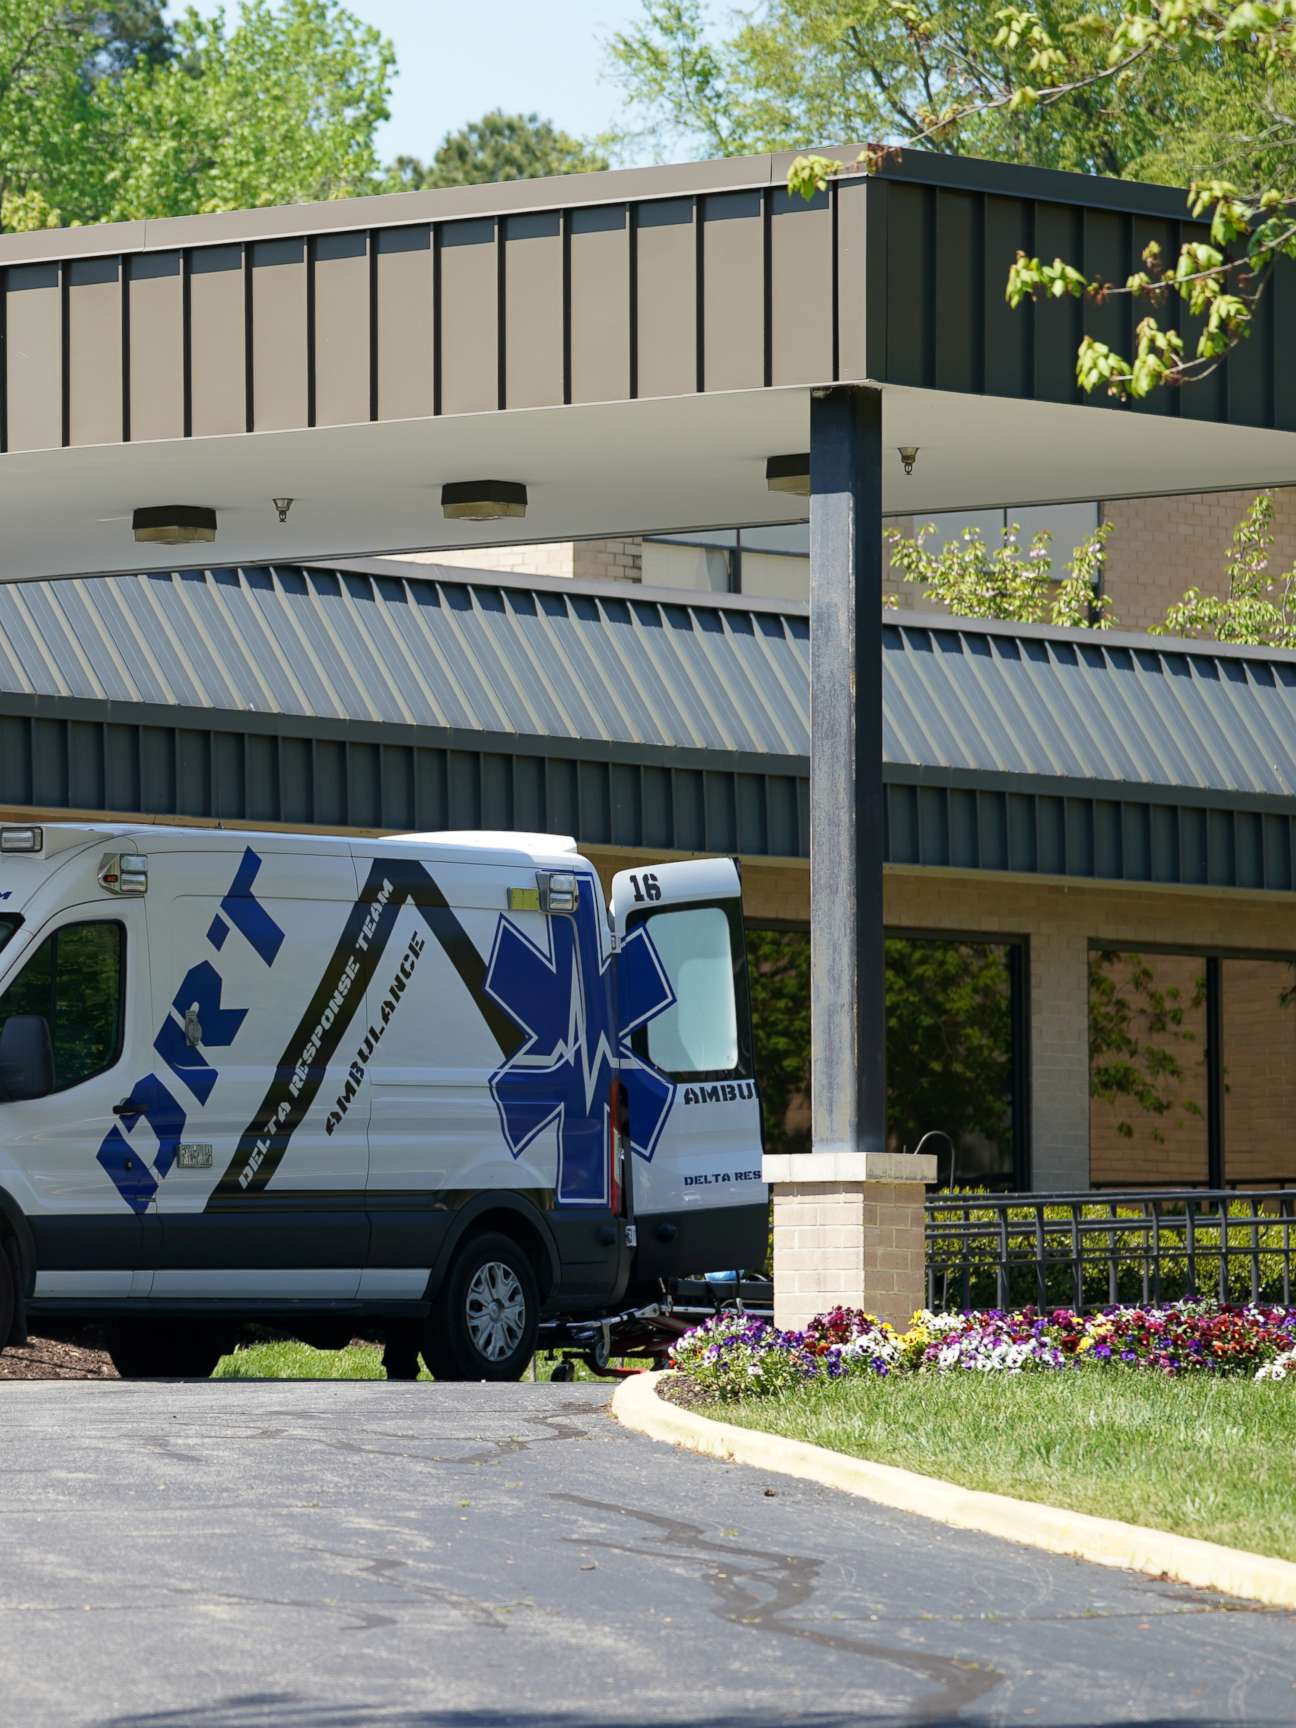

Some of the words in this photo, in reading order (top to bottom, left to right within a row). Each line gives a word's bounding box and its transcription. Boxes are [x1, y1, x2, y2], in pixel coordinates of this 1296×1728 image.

[629, 872, 662, 902] 16
[237, 1100, 292, 1190] DELTA
[288, 954, 361, 1098] RESPONSE
[355, 876, 395, 952] TEAM
[324, 929, 426, 1137] AMBULANCE
[684, 1172, 731, 1186] DELTA
